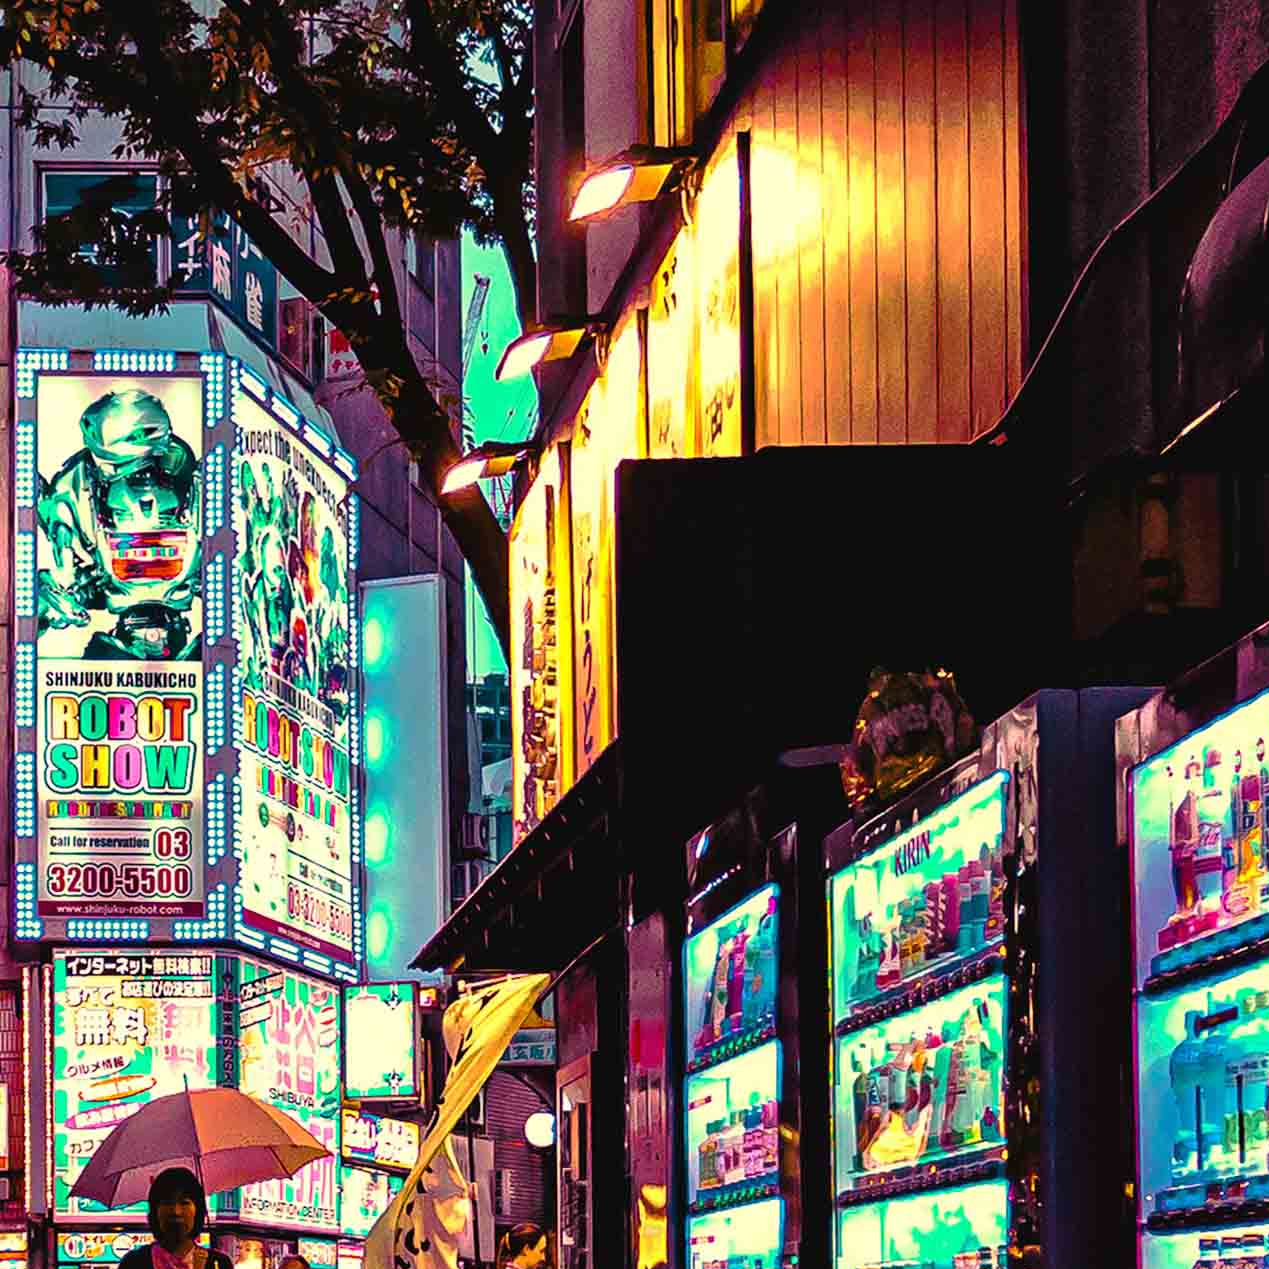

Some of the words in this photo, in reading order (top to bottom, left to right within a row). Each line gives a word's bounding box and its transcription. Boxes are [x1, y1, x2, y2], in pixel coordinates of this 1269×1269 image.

[45, 671, 113, 687] SHINJUKU
[116, 672, 197, 689] KABUKICHO
[50, 695, 192, 742] ROBOT
[243, 692, 301, 771] ROBOT
[302, 727, 349, 799] SHOW
[49, 743, 191, 789] SHOW
[49, 801, 97, 817] ROBOT
[50, 835, 70, 848] Call
[72, 835, 88, 847] for
[89, 836, 150, 848] reservation
[157, 831, 189, 857] 03
[895, 830, 931, 877] KIRIN
[50, 866, 189, 894] 3200-5500
[56, 903, 184, 915] www.shinjuku-robot.com
[74, 1006, 149, 1046] 無料
[268, 1087, 315, 1108] SHIBUYA
